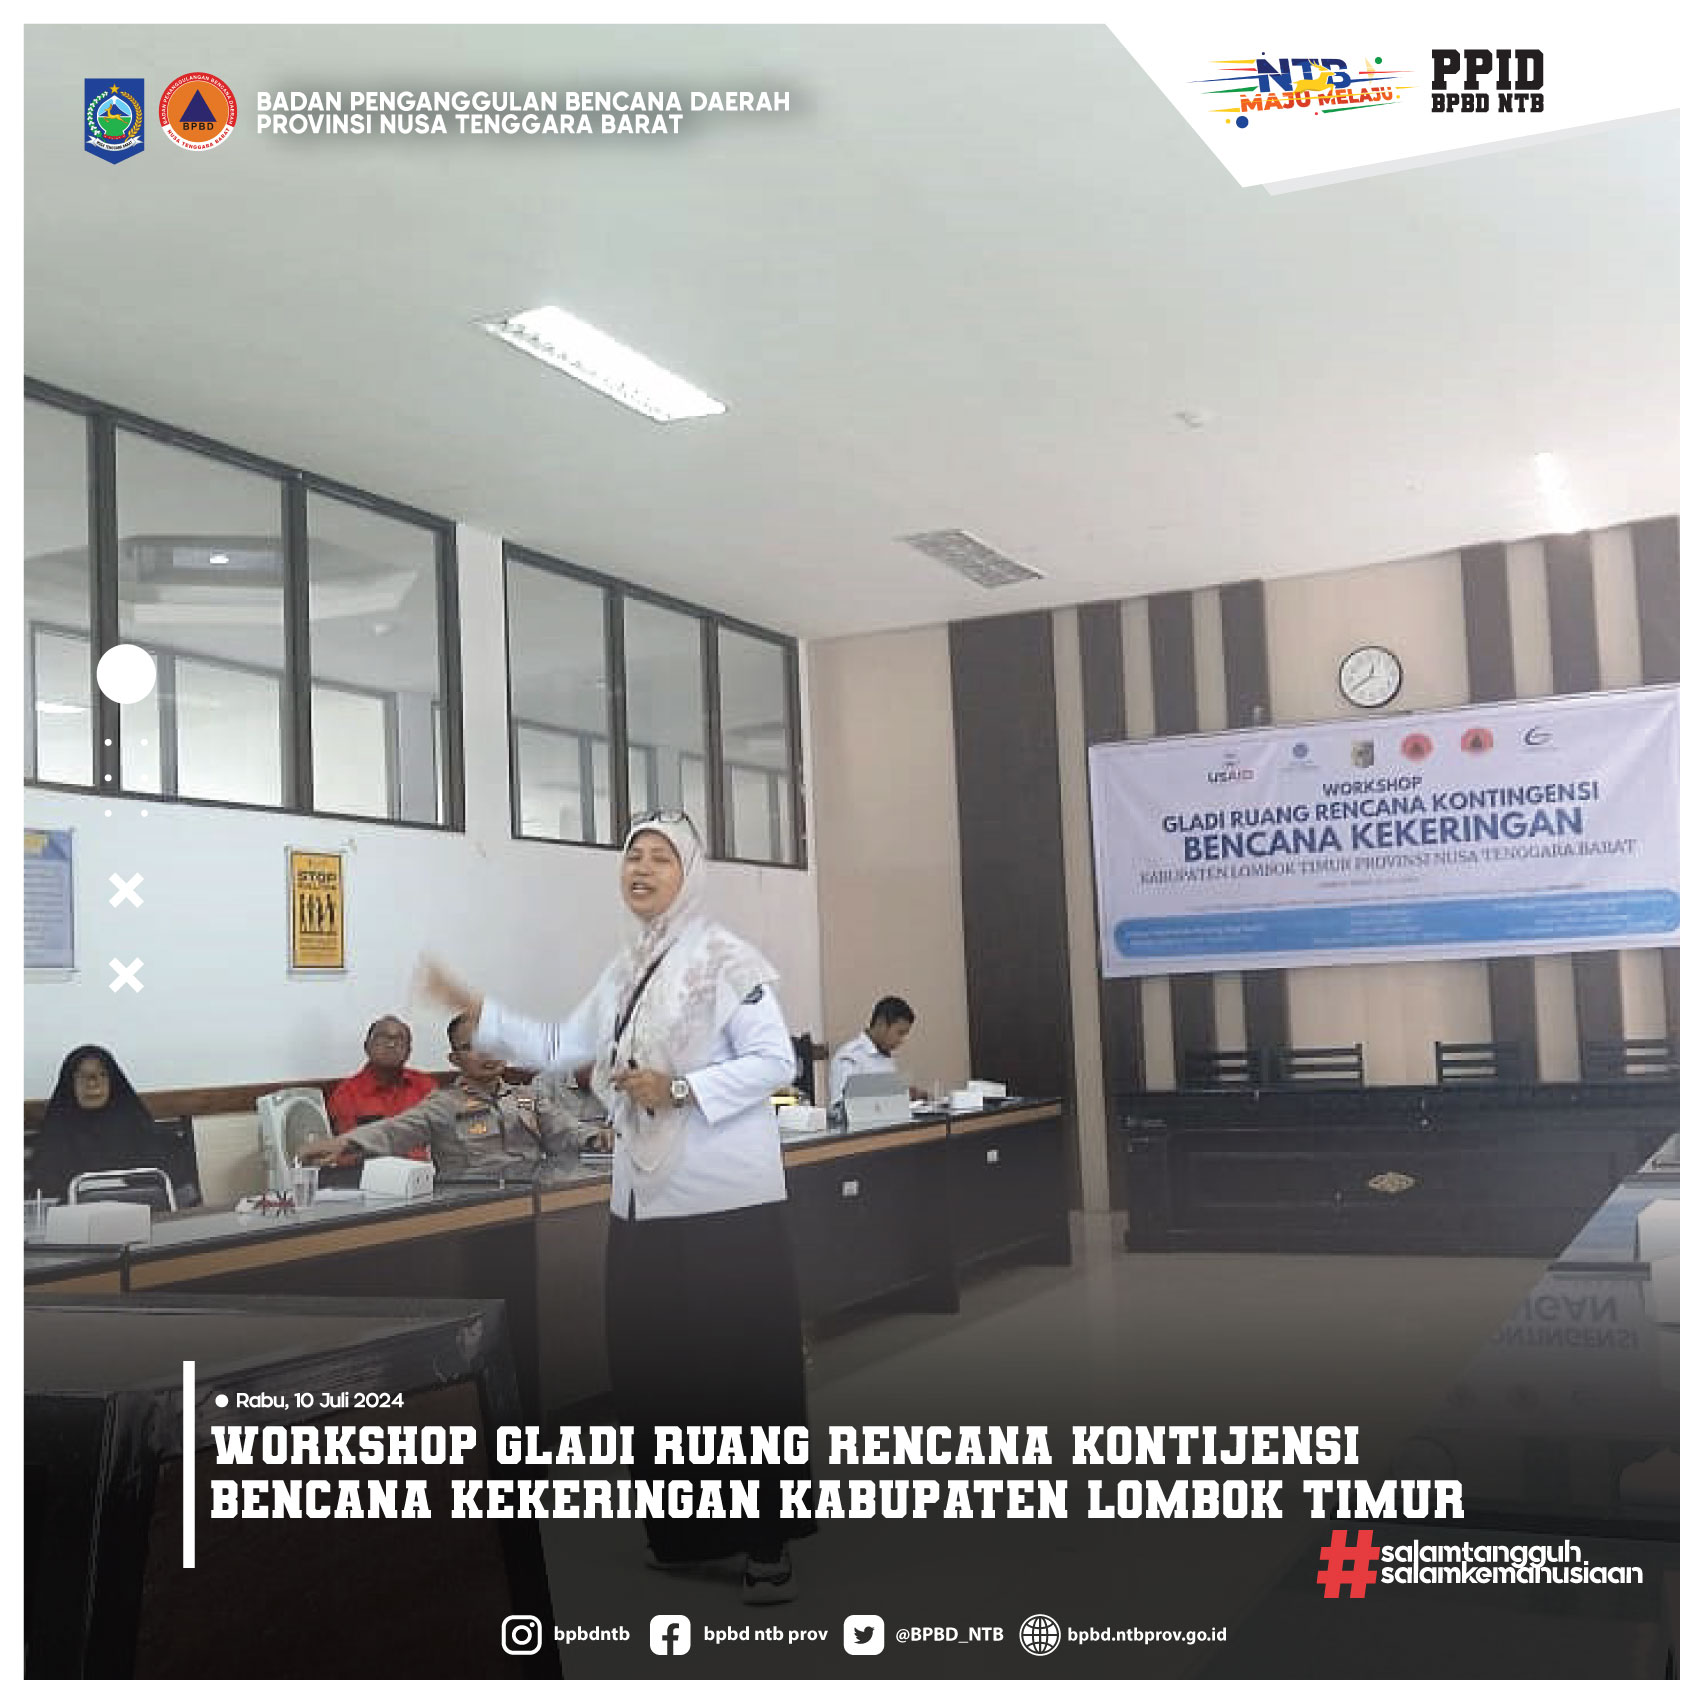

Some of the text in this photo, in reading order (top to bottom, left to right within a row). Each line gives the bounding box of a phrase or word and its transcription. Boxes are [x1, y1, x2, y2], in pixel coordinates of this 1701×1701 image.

[1162, 781, 1599, 832] GLADI RUANG RENCANA KONTINGENSI
[1322, 776, 1422, 796] WORKSHOP
[1184, 806, 1583, 863] BENCANA KEKERINGAN
[1140, 839, 1637, 884] KABUPATEN LOMBOK TIMUR PROVINSI NUSA TENGGARA BARAT
